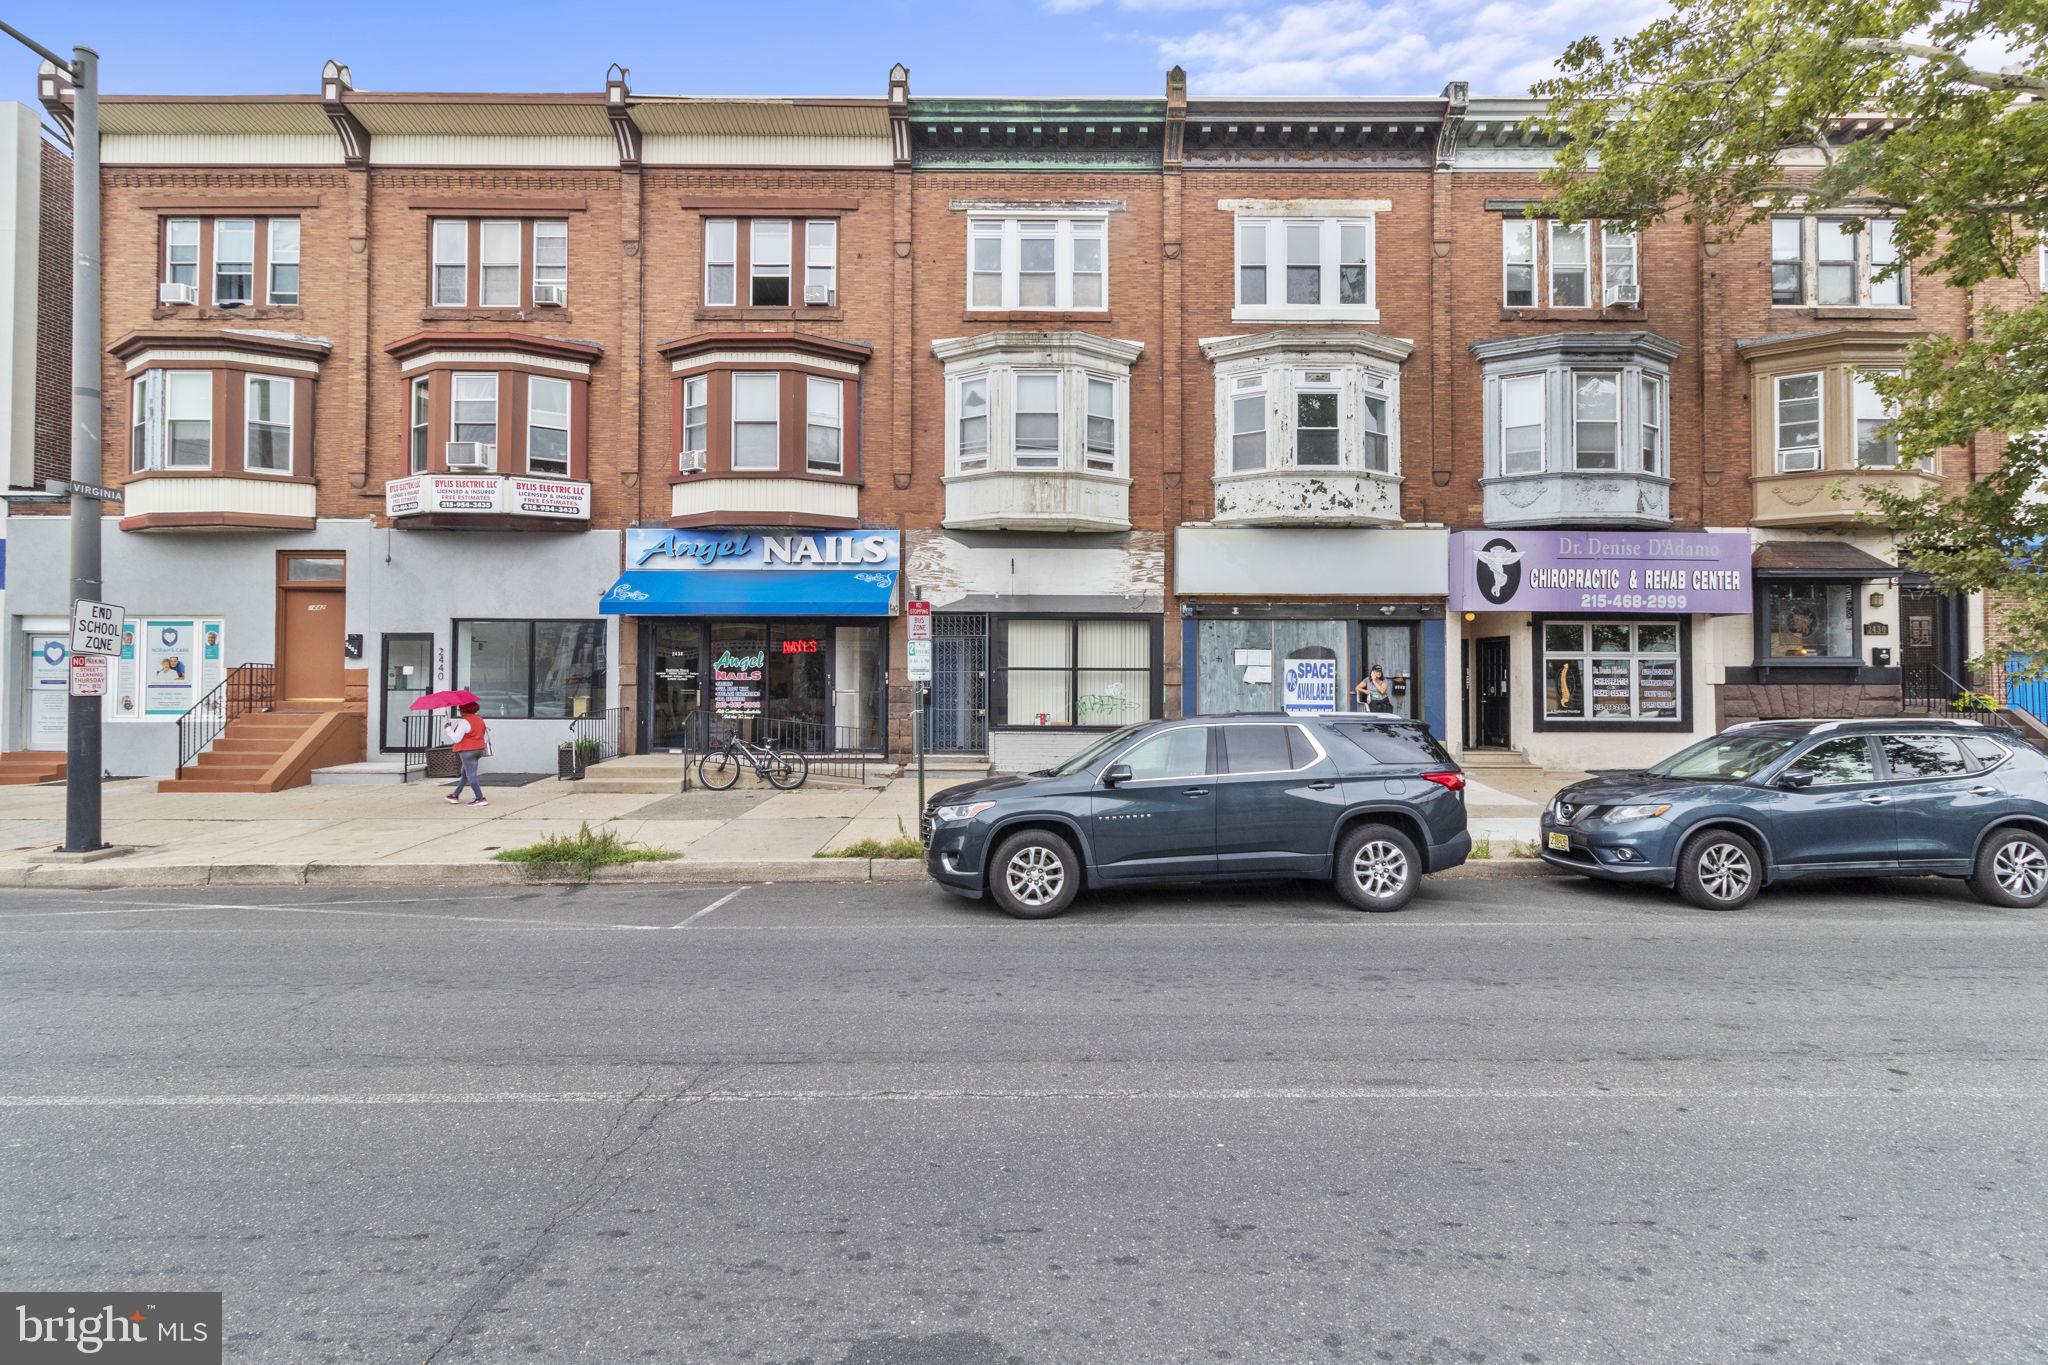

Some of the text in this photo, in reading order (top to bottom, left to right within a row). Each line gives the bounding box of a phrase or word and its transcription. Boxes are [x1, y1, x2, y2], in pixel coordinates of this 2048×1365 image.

[73, 483, 123, 501] VIRGINIA
[435, 480, 497, 488] BYLIS ELECTRIC LLC
[516, 482, 585, 495] BYLIS ELECTRIC LLC
[523, 504, 578, 514] 215-954-3435
[636, 535, 888, 565] Angel NAILS
[1559, 537, 1583, 555] Dr.
[1587, 538, 1641, 556] Denise
[1530, 568, 1741, 590] CHIROPRACTIC & REHAB CENTER
[1581, 593, 1687, 609] 215-468-2999
[92, 605, 112, 620] END
[78, 619, 120, 637] SCHOOL
[85, 636, 113, 650] ZONE
[73, 657, 85, 666] NO
[712, 650, 764, 672] Angel
[715, 670, 762, 681] NAILS
[1297, 662, 1335, 679] SPACE
[1297, 682, 1334, 701] AVAILABLE
